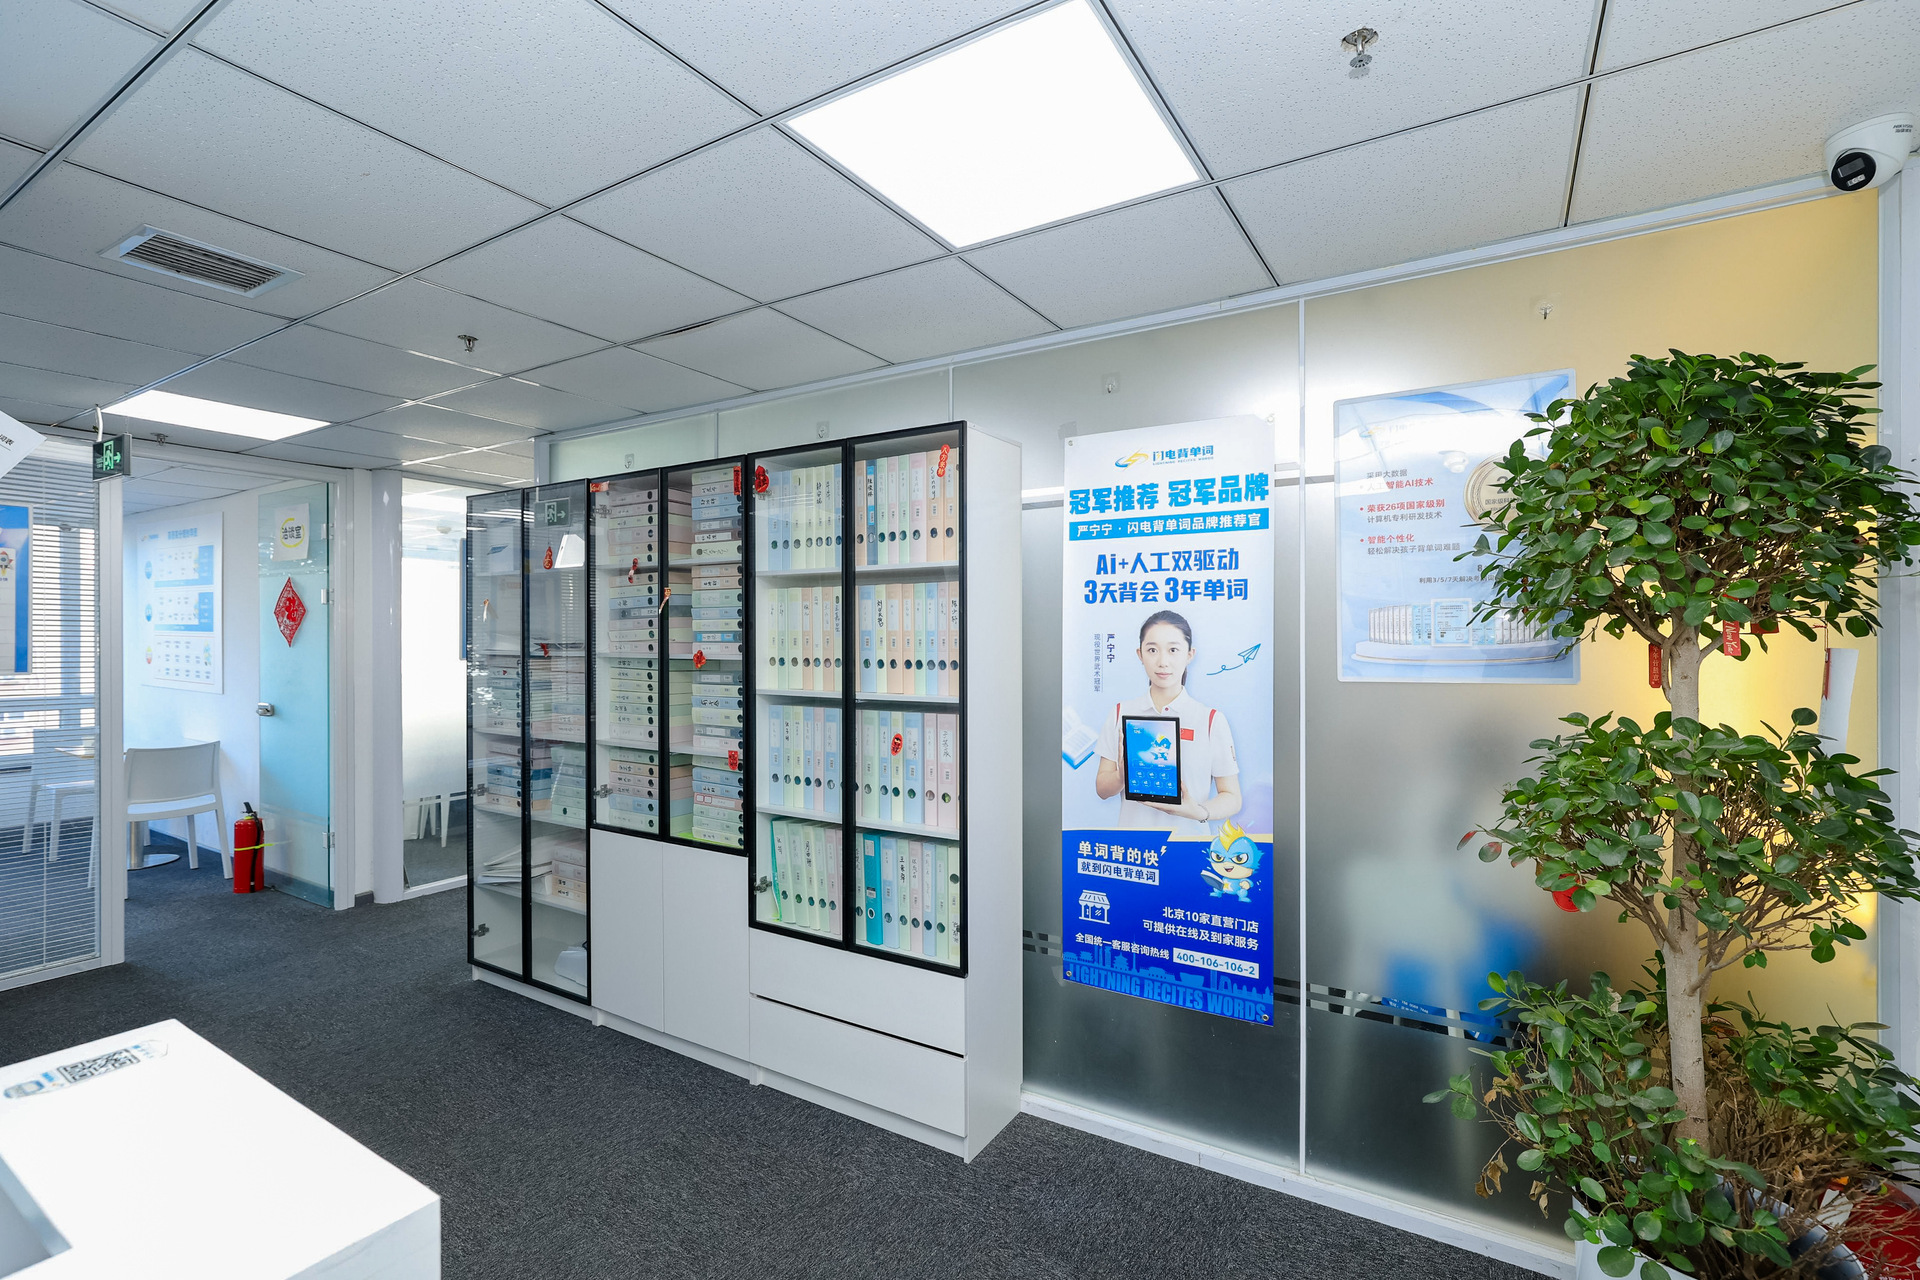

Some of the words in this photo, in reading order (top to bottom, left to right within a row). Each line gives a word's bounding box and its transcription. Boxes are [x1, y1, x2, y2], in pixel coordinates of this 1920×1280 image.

[1069, 482, 1159, 515] 冠军推荐
[1168, 472, 1269, 507] 冠军品牌
[1367, 499, 1445, 513] 荣获26项国家级别
[1367, 511, 1443, 524] 计算机专利研发技术
[1367, 534, 1415, 544] 智能个性化
[1367, 542, 1461, 555] 轻松解决孩子背单词难题
[1106, 633, 1116, 663] 严宁宁
[1077, 841, 1159, 867] 单词背的快
[1081, 860, 1156, 883] 就到闪电背单词
[1162, 906, 1259, 933] 北京10家直营门店
[1142, 919, 1259, 951] 可提供在线及到家服务
[1075, 932, 1170, 960] 全国统一客服咨询热线
[1176, 949, 1256, 976] 400-106-106-2
[1069, 963, 1141, 996] LIGHTNING
[1143, 977, 1204, 1010] RECITES
[1206, 992, 1267, 1023] WORDS
